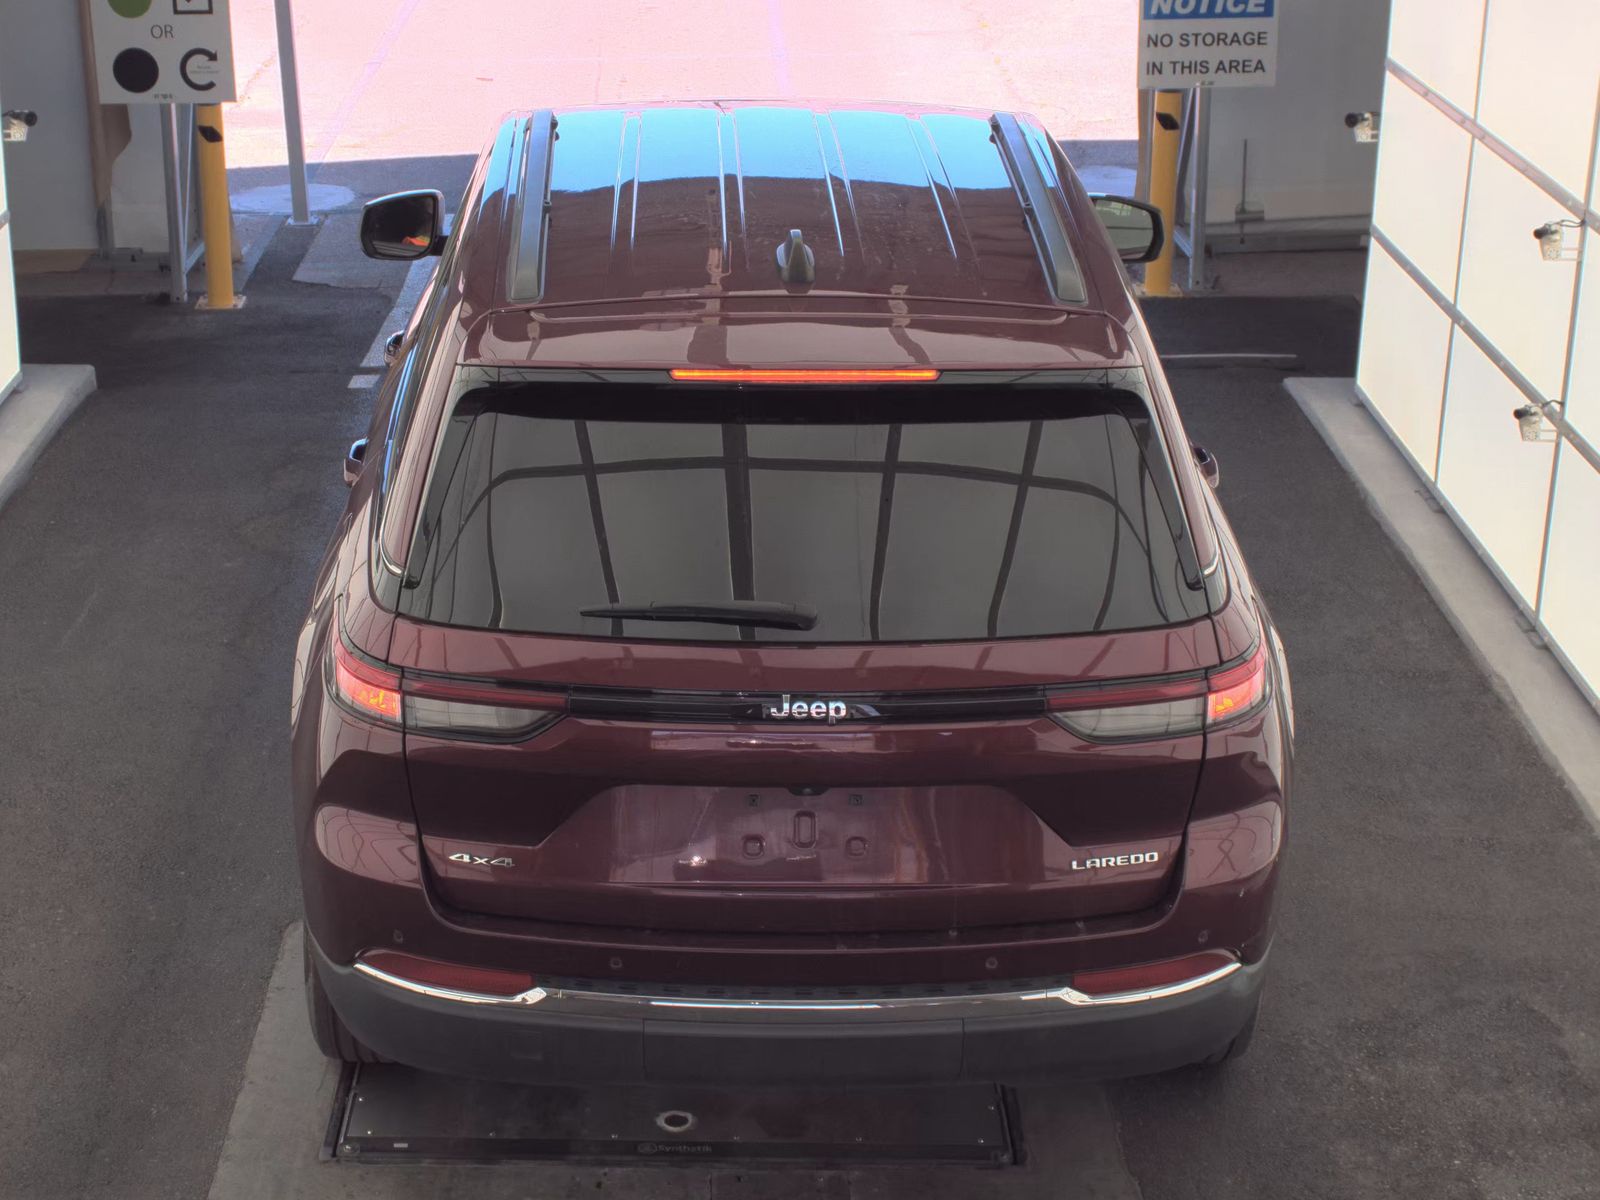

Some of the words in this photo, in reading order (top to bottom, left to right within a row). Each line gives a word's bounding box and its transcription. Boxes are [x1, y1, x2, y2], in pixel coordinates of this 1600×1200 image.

[1150, 0, 1266, 15] NOTICE
[150, 24, 174, 39] OR
[1146, 33, 1173, 48] NO
[1179, 31, 1268, 47] STORAGE
[1146, 61, 1163, 75] IN
[1169, 60, 1210, 75] THIS
[1215, 59, 1266, 74] AREA
[770, 694, 847, 726] Jeep
[1071, 851, 1159, 870] LAREDO
